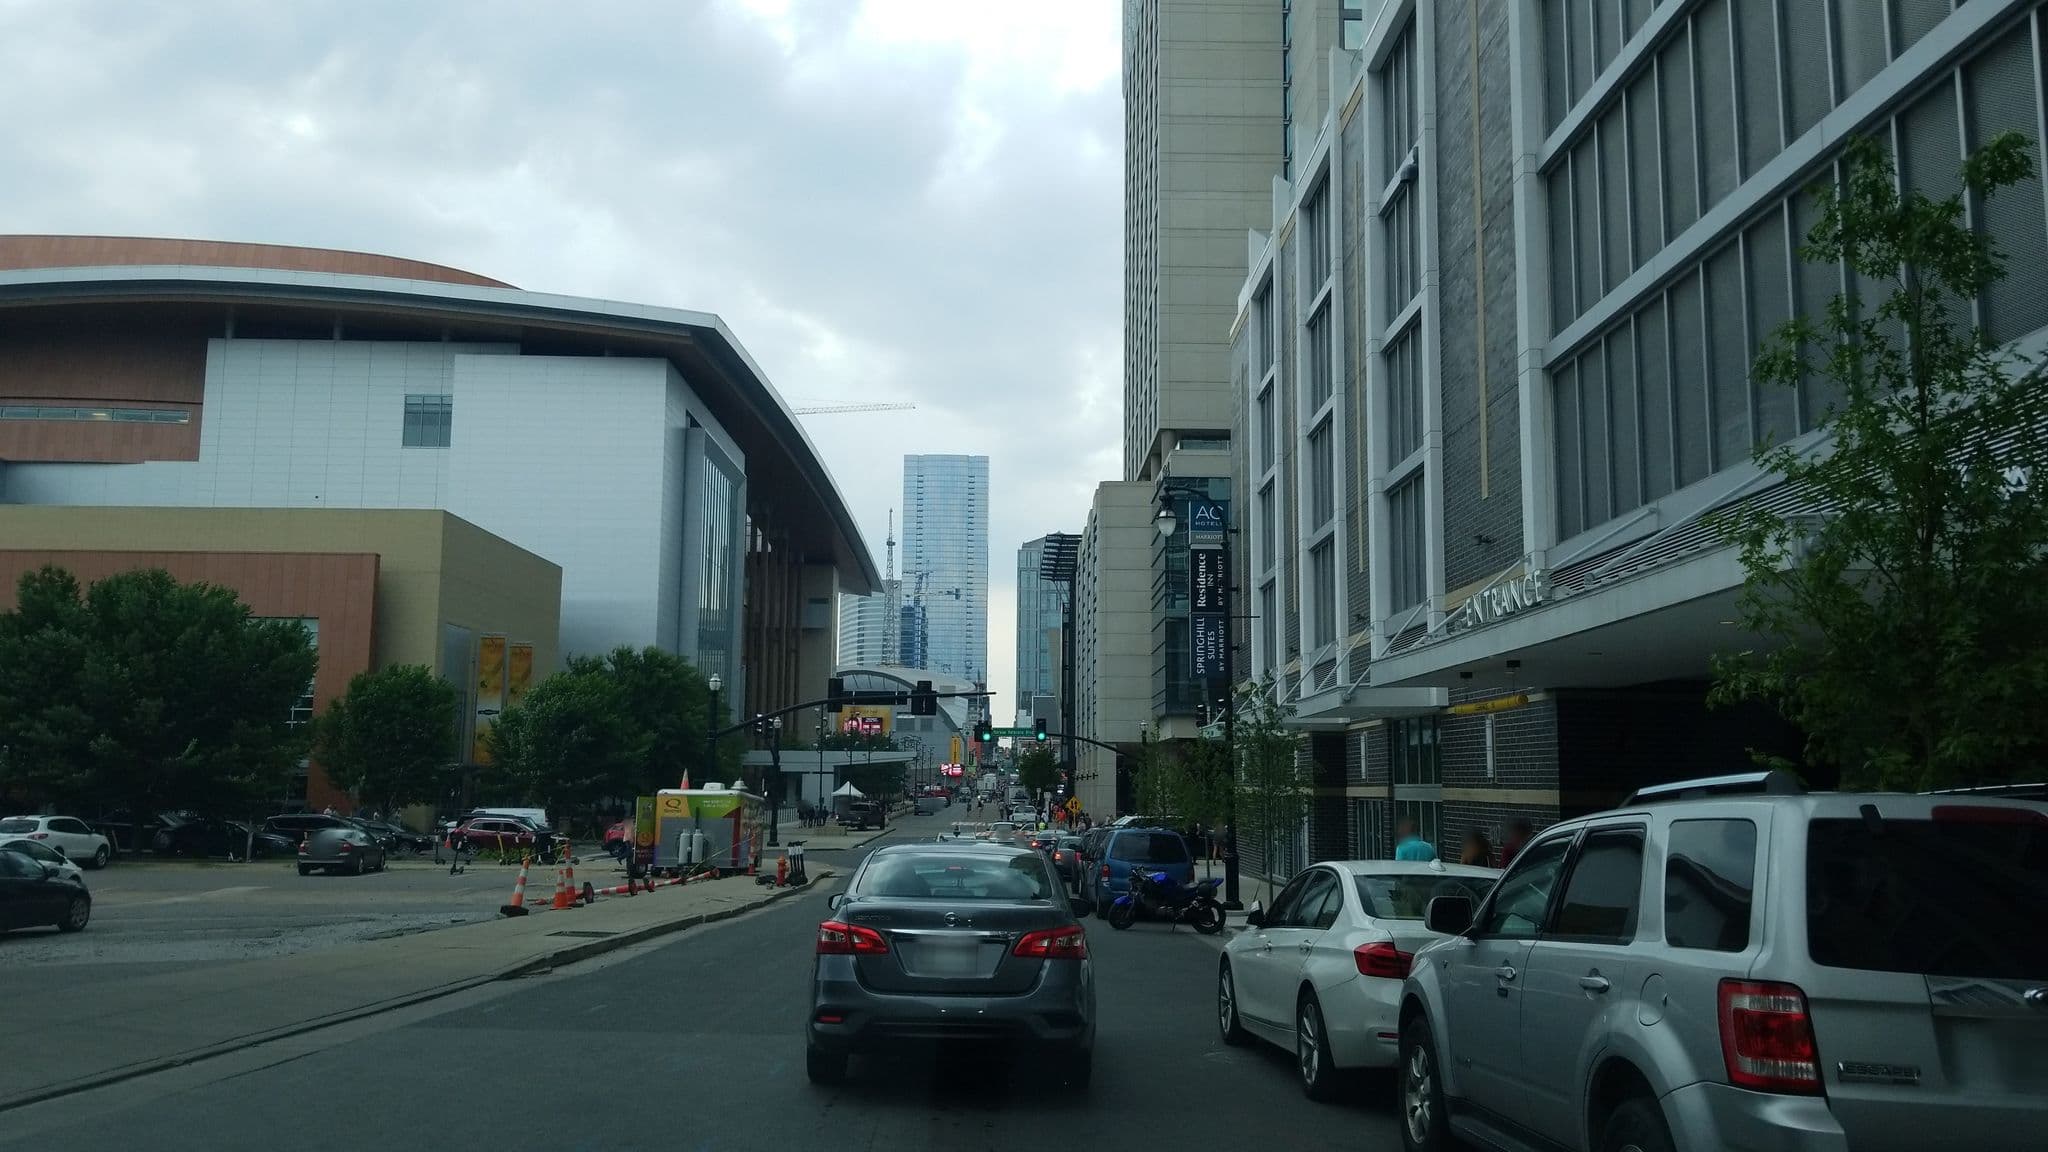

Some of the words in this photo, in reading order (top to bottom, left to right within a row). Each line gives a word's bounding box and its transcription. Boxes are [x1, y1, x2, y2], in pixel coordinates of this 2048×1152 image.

[1195, 505, 1224, 520] AC
[1196, 553, 1206, 607] Residence
[1217, 596, 1223, 606] BY
[1465, 569, 1543, 627] ENTRANCE
[1196, 617, 1205, 674] SPRINGHILL
[1207, 631, 1215, 660] SUITES
[1218, 661, 1225, 672] BY
